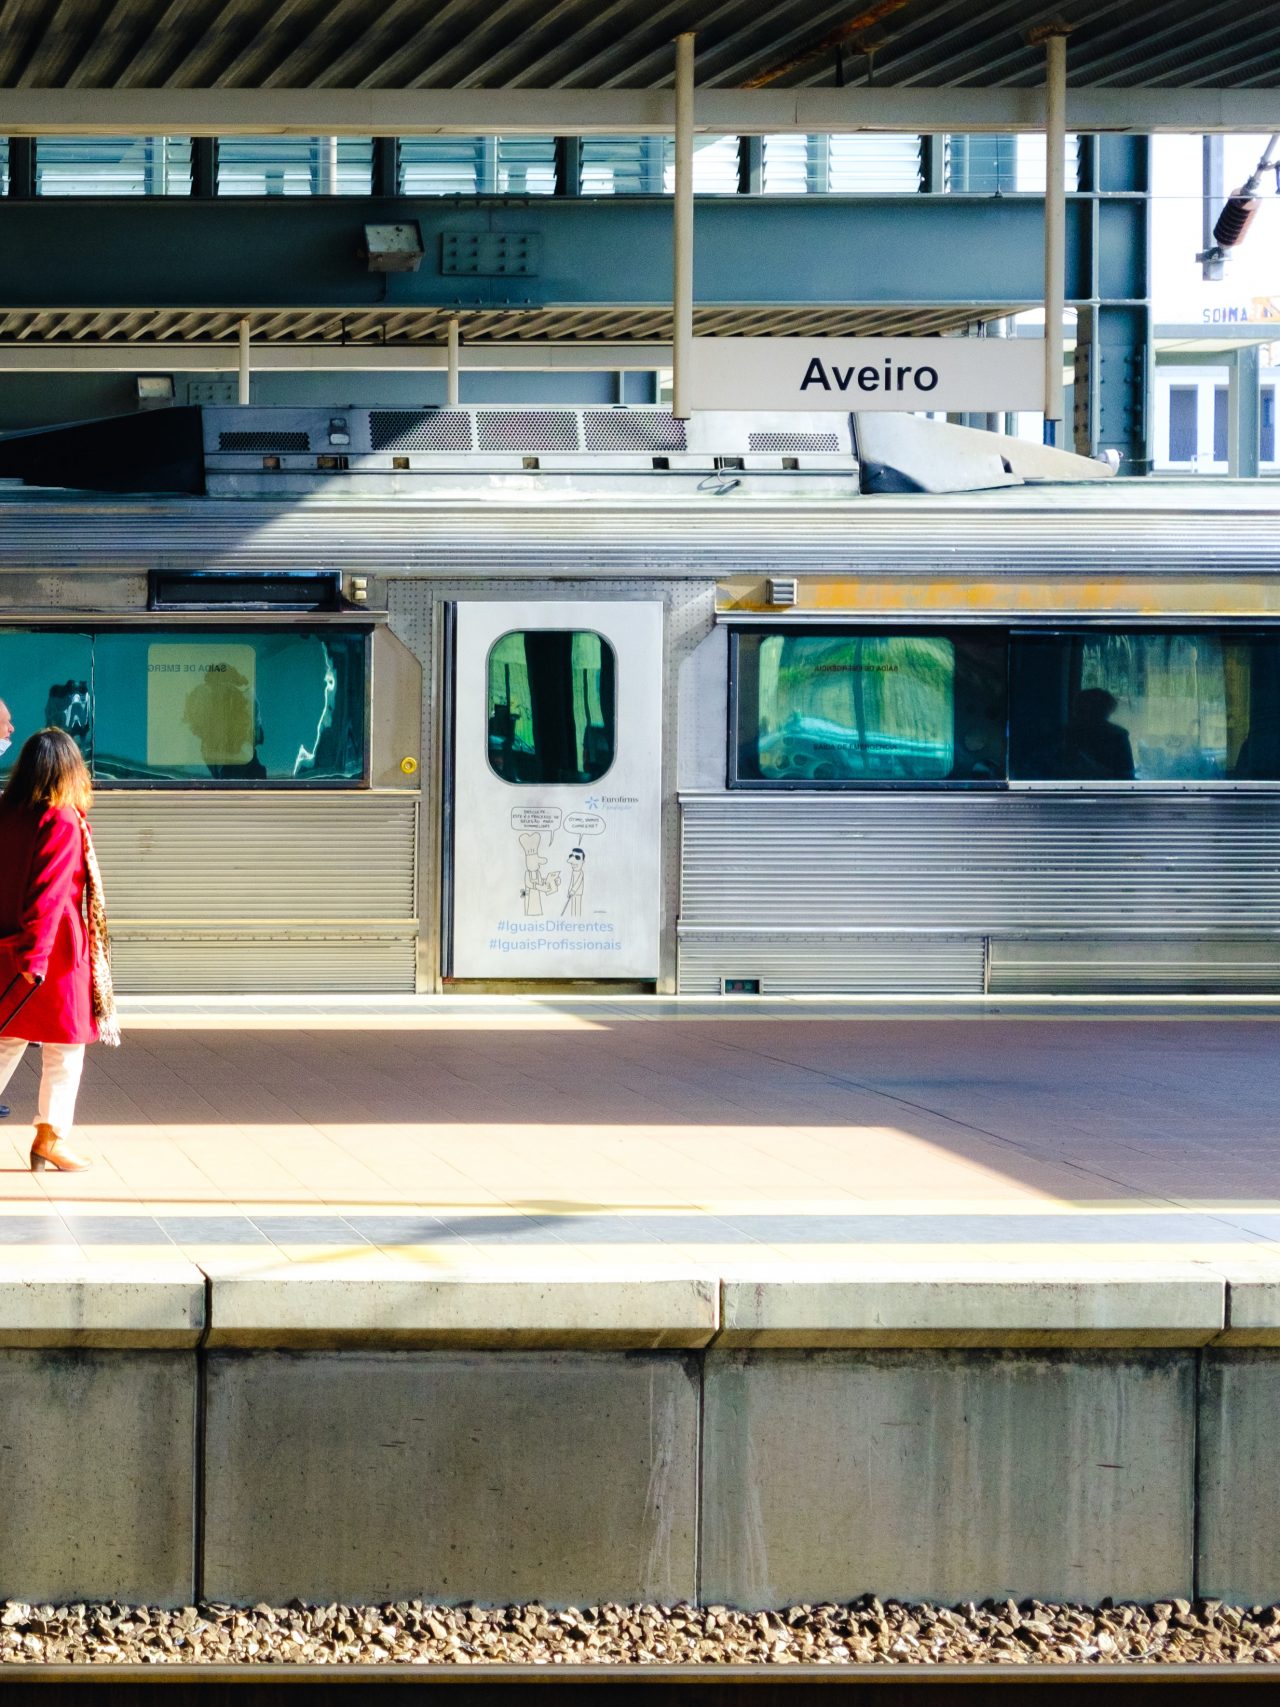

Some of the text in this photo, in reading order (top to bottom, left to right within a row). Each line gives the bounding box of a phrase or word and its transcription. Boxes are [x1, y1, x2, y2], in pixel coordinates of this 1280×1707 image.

[799, 357, 939, 392] Aveiro
[601, 795, 639, 803] Eurofirms
[497, 920, 614, 934] #IguaisDiferentes
[489, 938, 622, 952] #IguaisProfissionais
